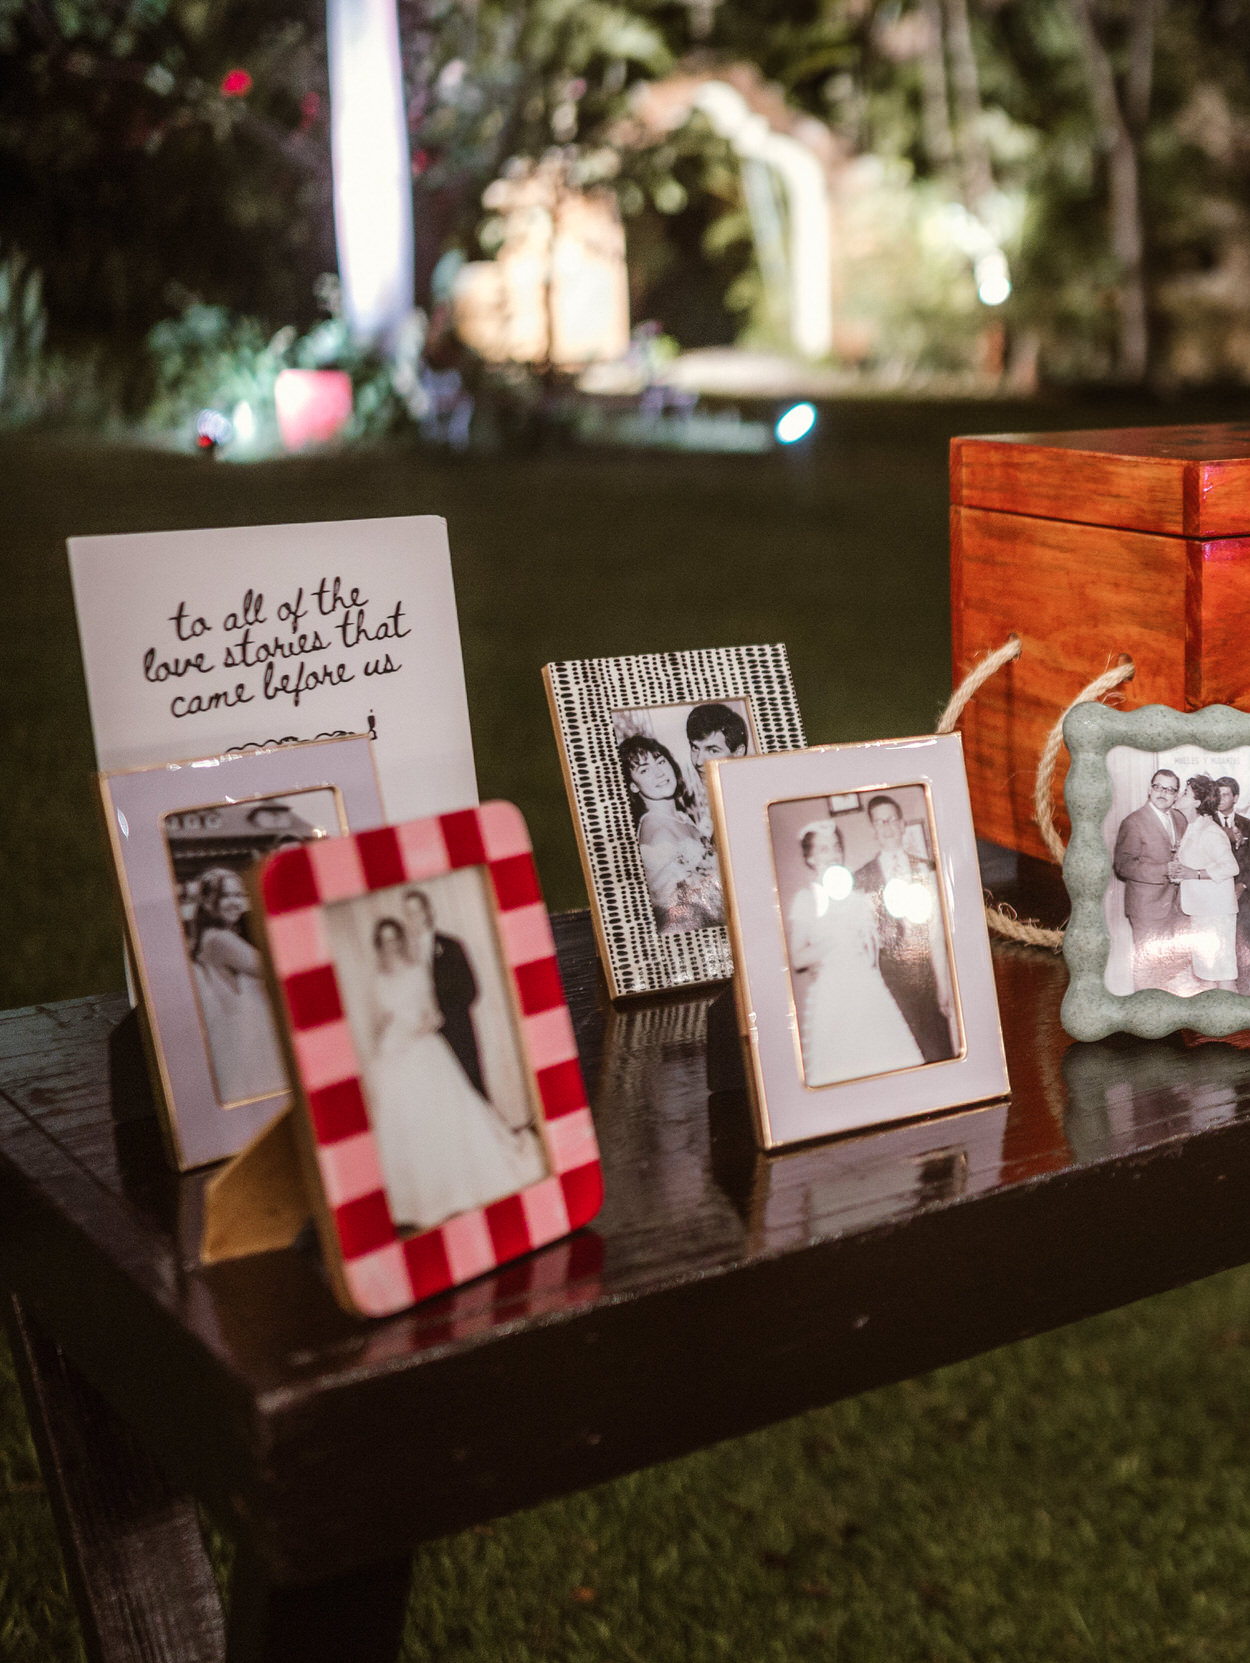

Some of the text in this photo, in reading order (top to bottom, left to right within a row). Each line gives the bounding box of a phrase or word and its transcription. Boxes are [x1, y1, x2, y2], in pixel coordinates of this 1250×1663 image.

[142, 601, 412, 683] love stories that
[168, 576, 369, 642] to all of the
[170, 653, 402, 719] came before us
